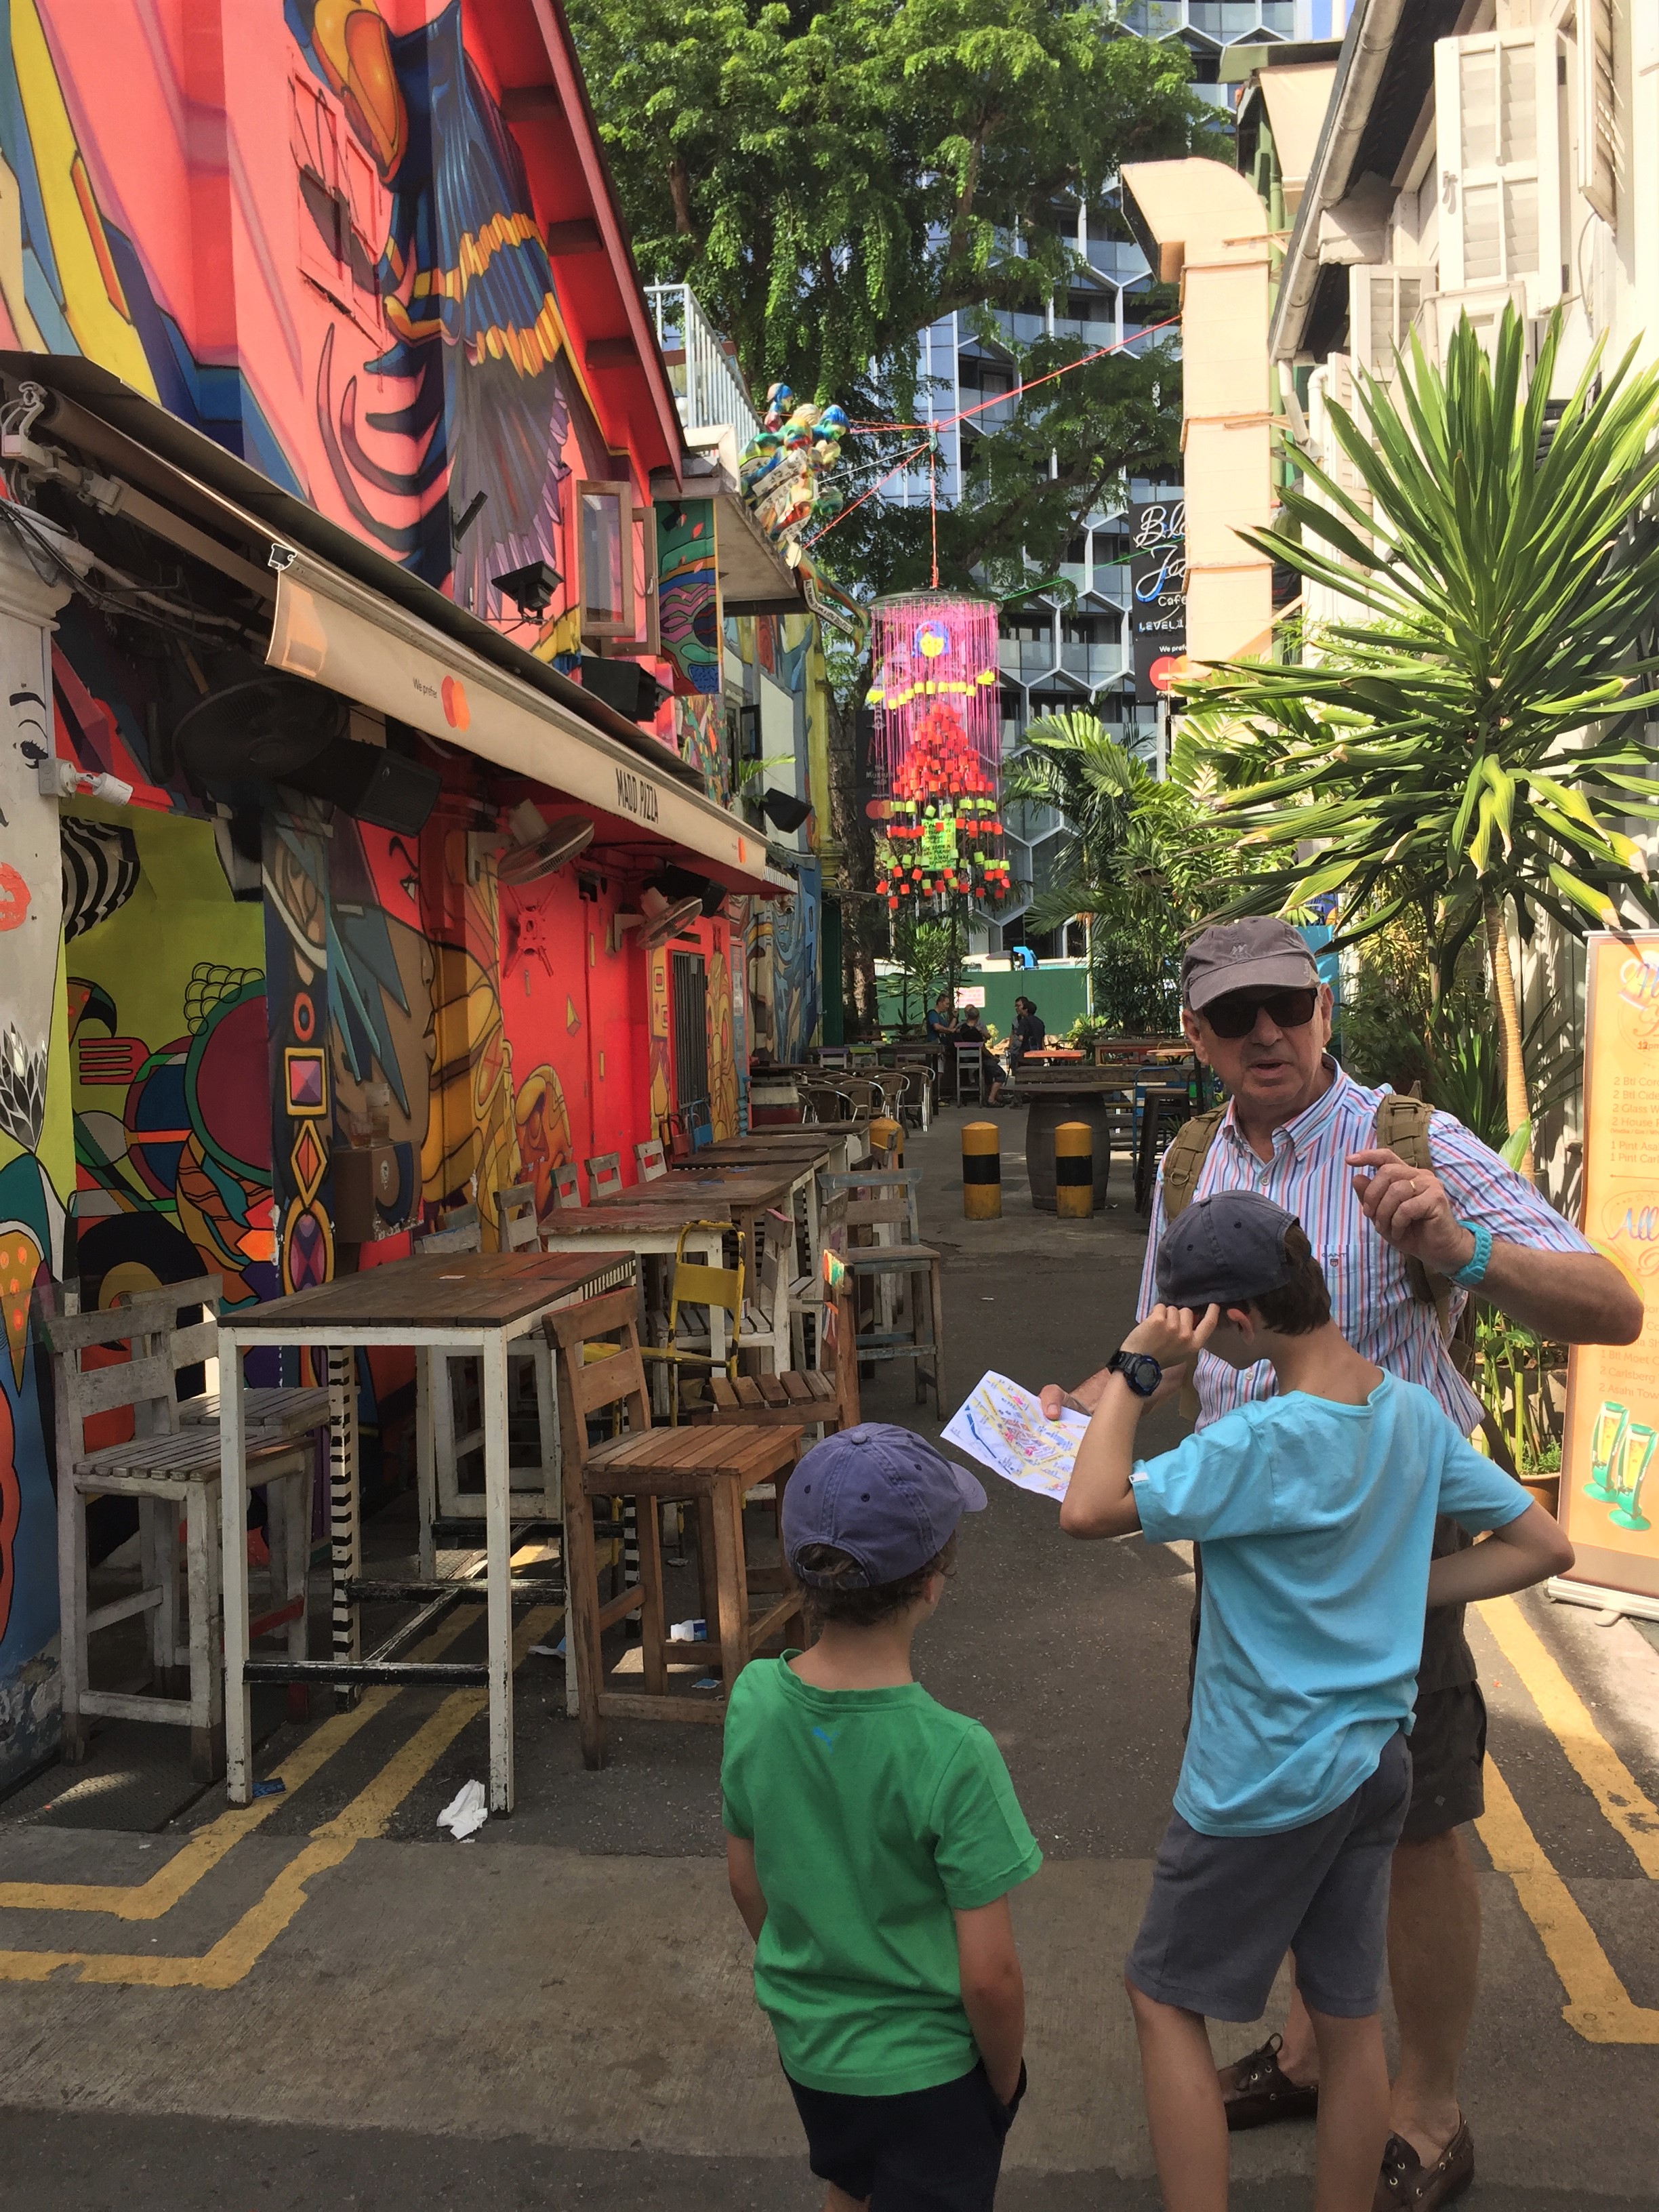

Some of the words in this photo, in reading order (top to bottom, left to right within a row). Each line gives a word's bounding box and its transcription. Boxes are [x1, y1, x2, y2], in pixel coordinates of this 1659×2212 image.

[1139, 620, 1174, 632] LEVEL
[413, 678, 422, 692] We
[423, 685, 438, 699] prefer
[615, 767, 638, 814] MADD
[640, 780, 659, 824] PIZZA
[1614, 1076, 1620, 1086] 2
[1623, 1077, 1636, 1086] Btl
[1613, 1090, 1620, 1099] 2
[1622, 1090, 1635, 1099] Btl
[1612, 1103, 1619, 1112] 2
[1621, 1103, 1647, 1113] Glass
[1612, 1117, 1618, 1126] 2
[1621, 1117, 1653, 1127] House
[1611, 1141, 1616, 1149] 1
[1618, 1141, 1637, 1151] Pint
[1610, 1153, 1616, 1162] 1
[1618, 1153, 1637, 1162] Pint
[1601, 1349, 1606, 1358] 1
[1609, 1350, 1621, 1359] Btl
[1624, 1352, 1649, 1364] Moet
[1599, 1366, 1606, 1374] 2
[1608, 1367, 1655, 1384] Carlsberg
[1599, 1382, 1605, 1392] 2
[1607, 1385, 1634, 1397] Asahi
